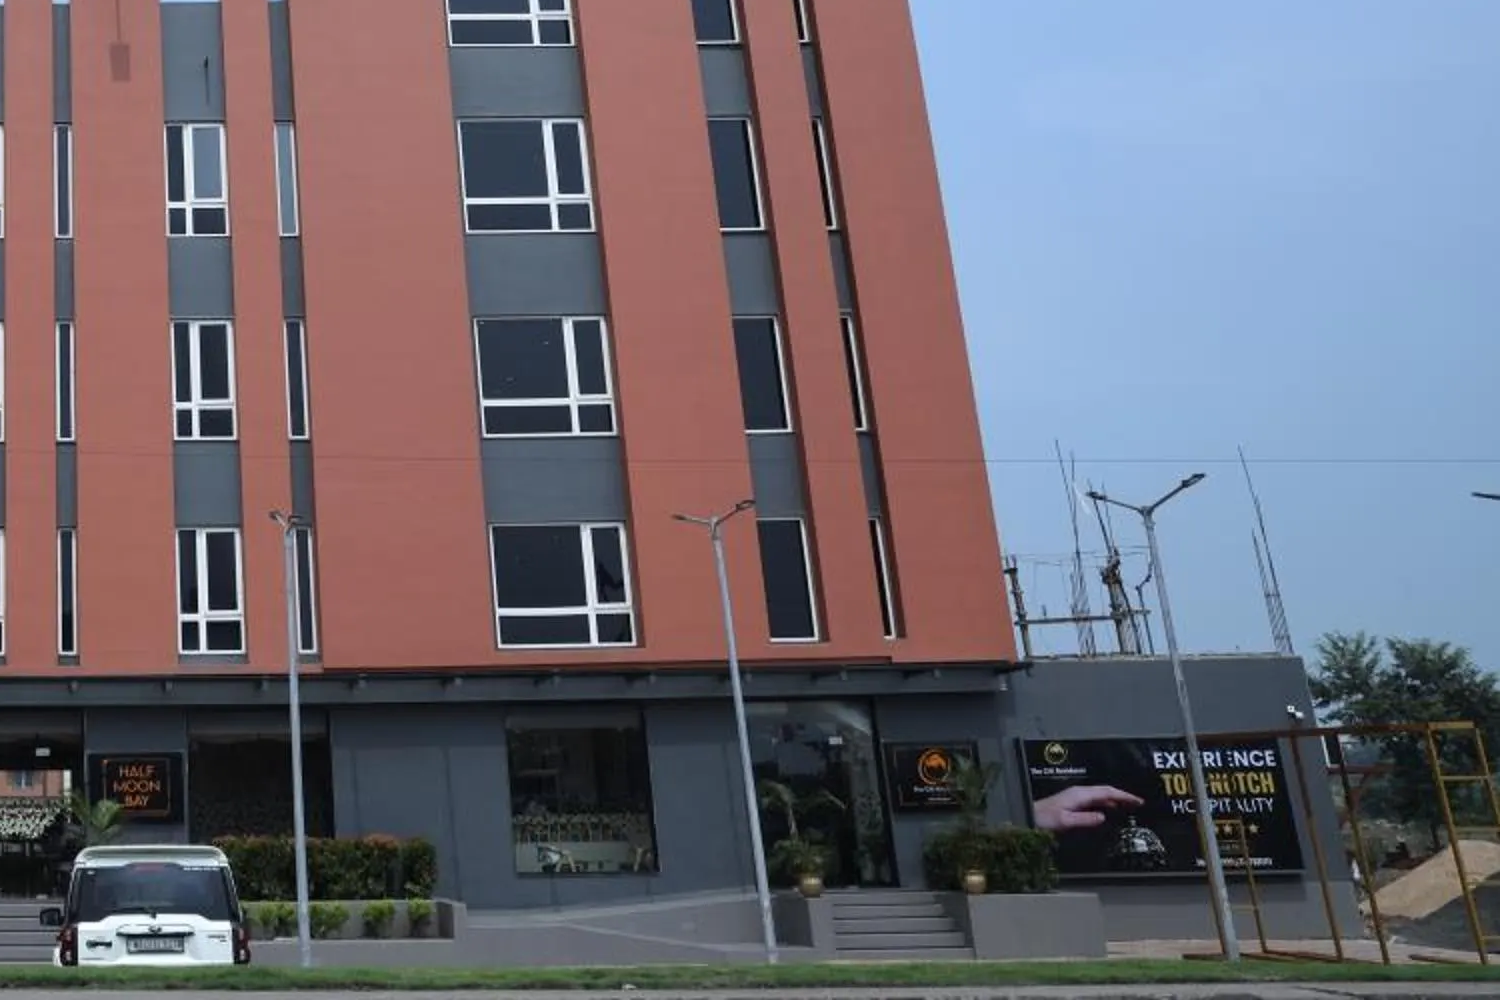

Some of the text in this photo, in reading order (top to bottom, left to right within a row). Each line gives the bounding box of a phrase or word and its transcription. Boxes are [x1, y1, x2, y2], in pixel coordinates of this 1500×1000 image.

[1153, 749, 1277, 770] EXRINCE
[118, 764, 156, 778] HALF
[112, 779, 161, 793] MOON
[1160, 771, 1276, 796] TO-NTCH
[124, 795, 150, 808] BAY
[1170, 797, 1275, 814] HOPITLITY
